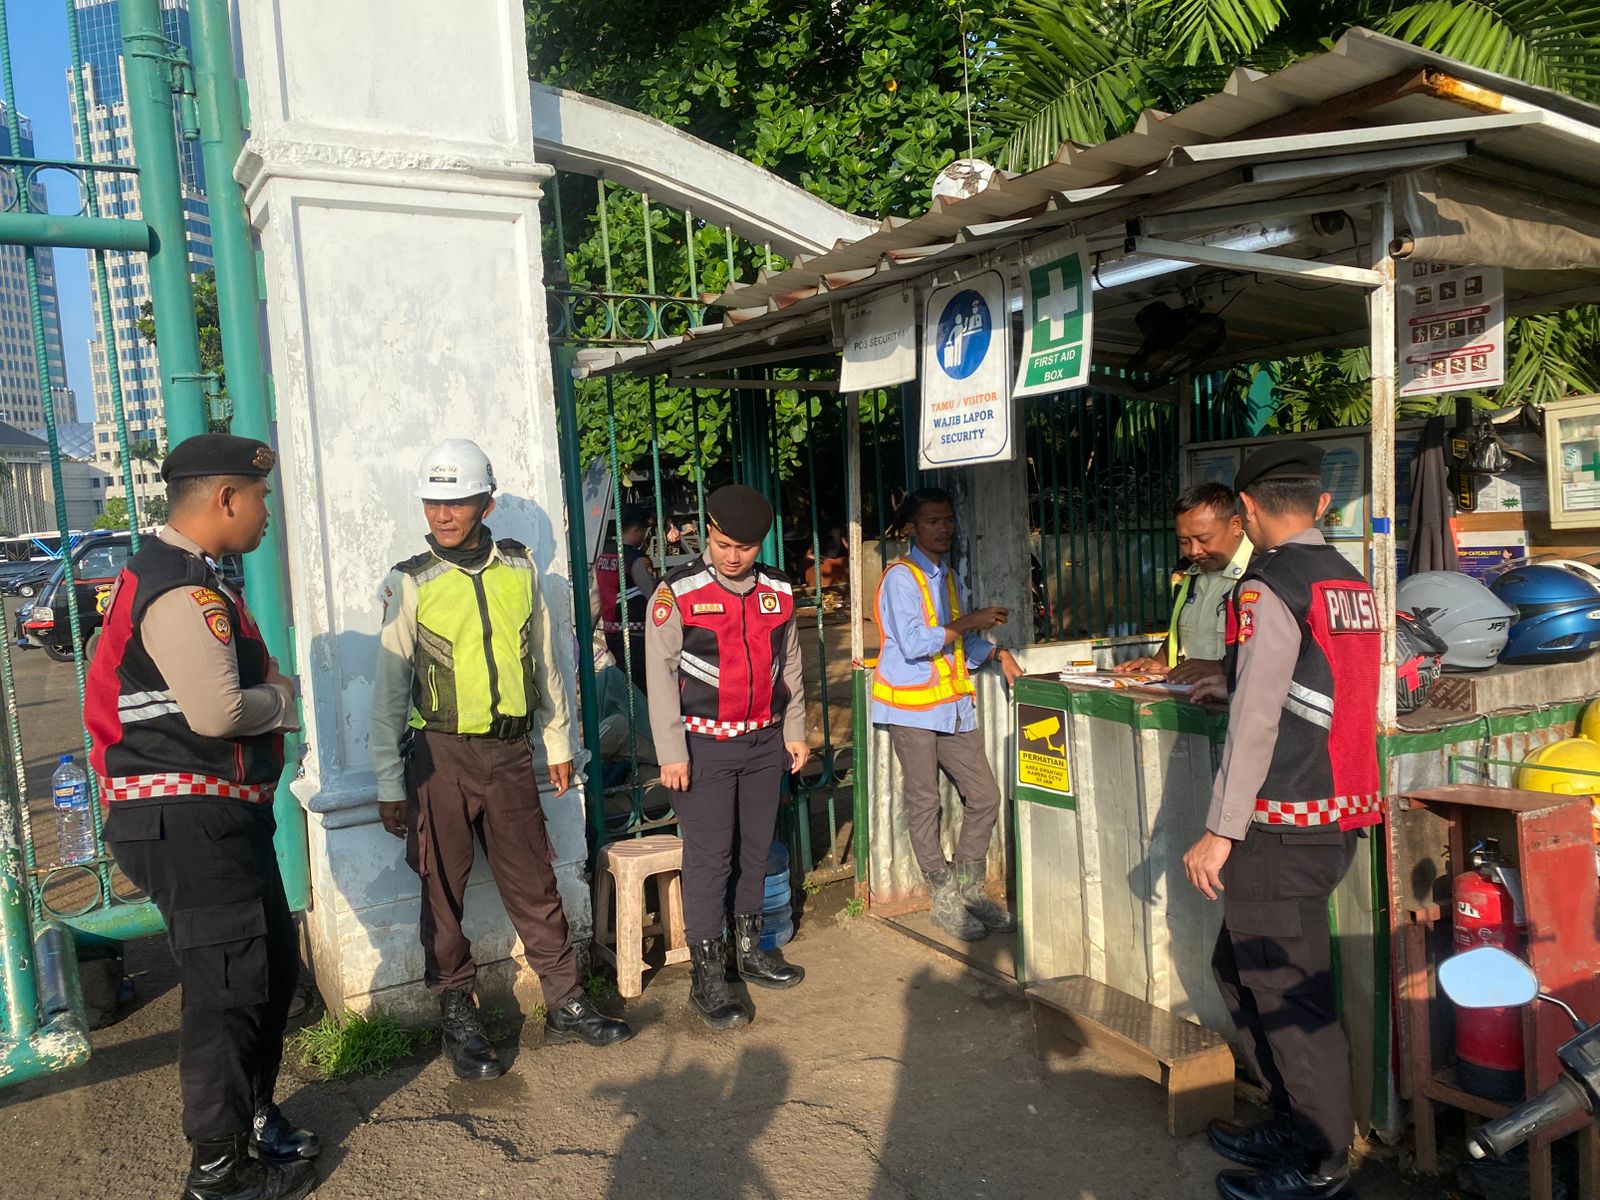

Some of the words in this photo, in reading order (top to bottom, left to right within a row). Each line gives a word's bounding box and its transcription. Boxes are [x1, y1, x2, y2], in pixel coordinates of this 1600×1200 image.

[854, 340, 868, 351] POS
[1034, 353, 1059, 368] FIRST
[1060, 349, 1076, 362] AID
[1044, 368, 1064, 382] BOX
[931, 400, 955, 412] TAMU
[957, 399, 961, 408] /
[963, 392, 998, 407] VISITOR
[933, 415, 961, 428] WAJIB
[963, 409, 994, 424] LAPOR
[941, 428, 985, 445] SECURITY
[597, 557, 618, 571] POLISI
[1326, 589, 1379, 629] POLISI
[1022, 752, 1064, 767] PERHATIAN
